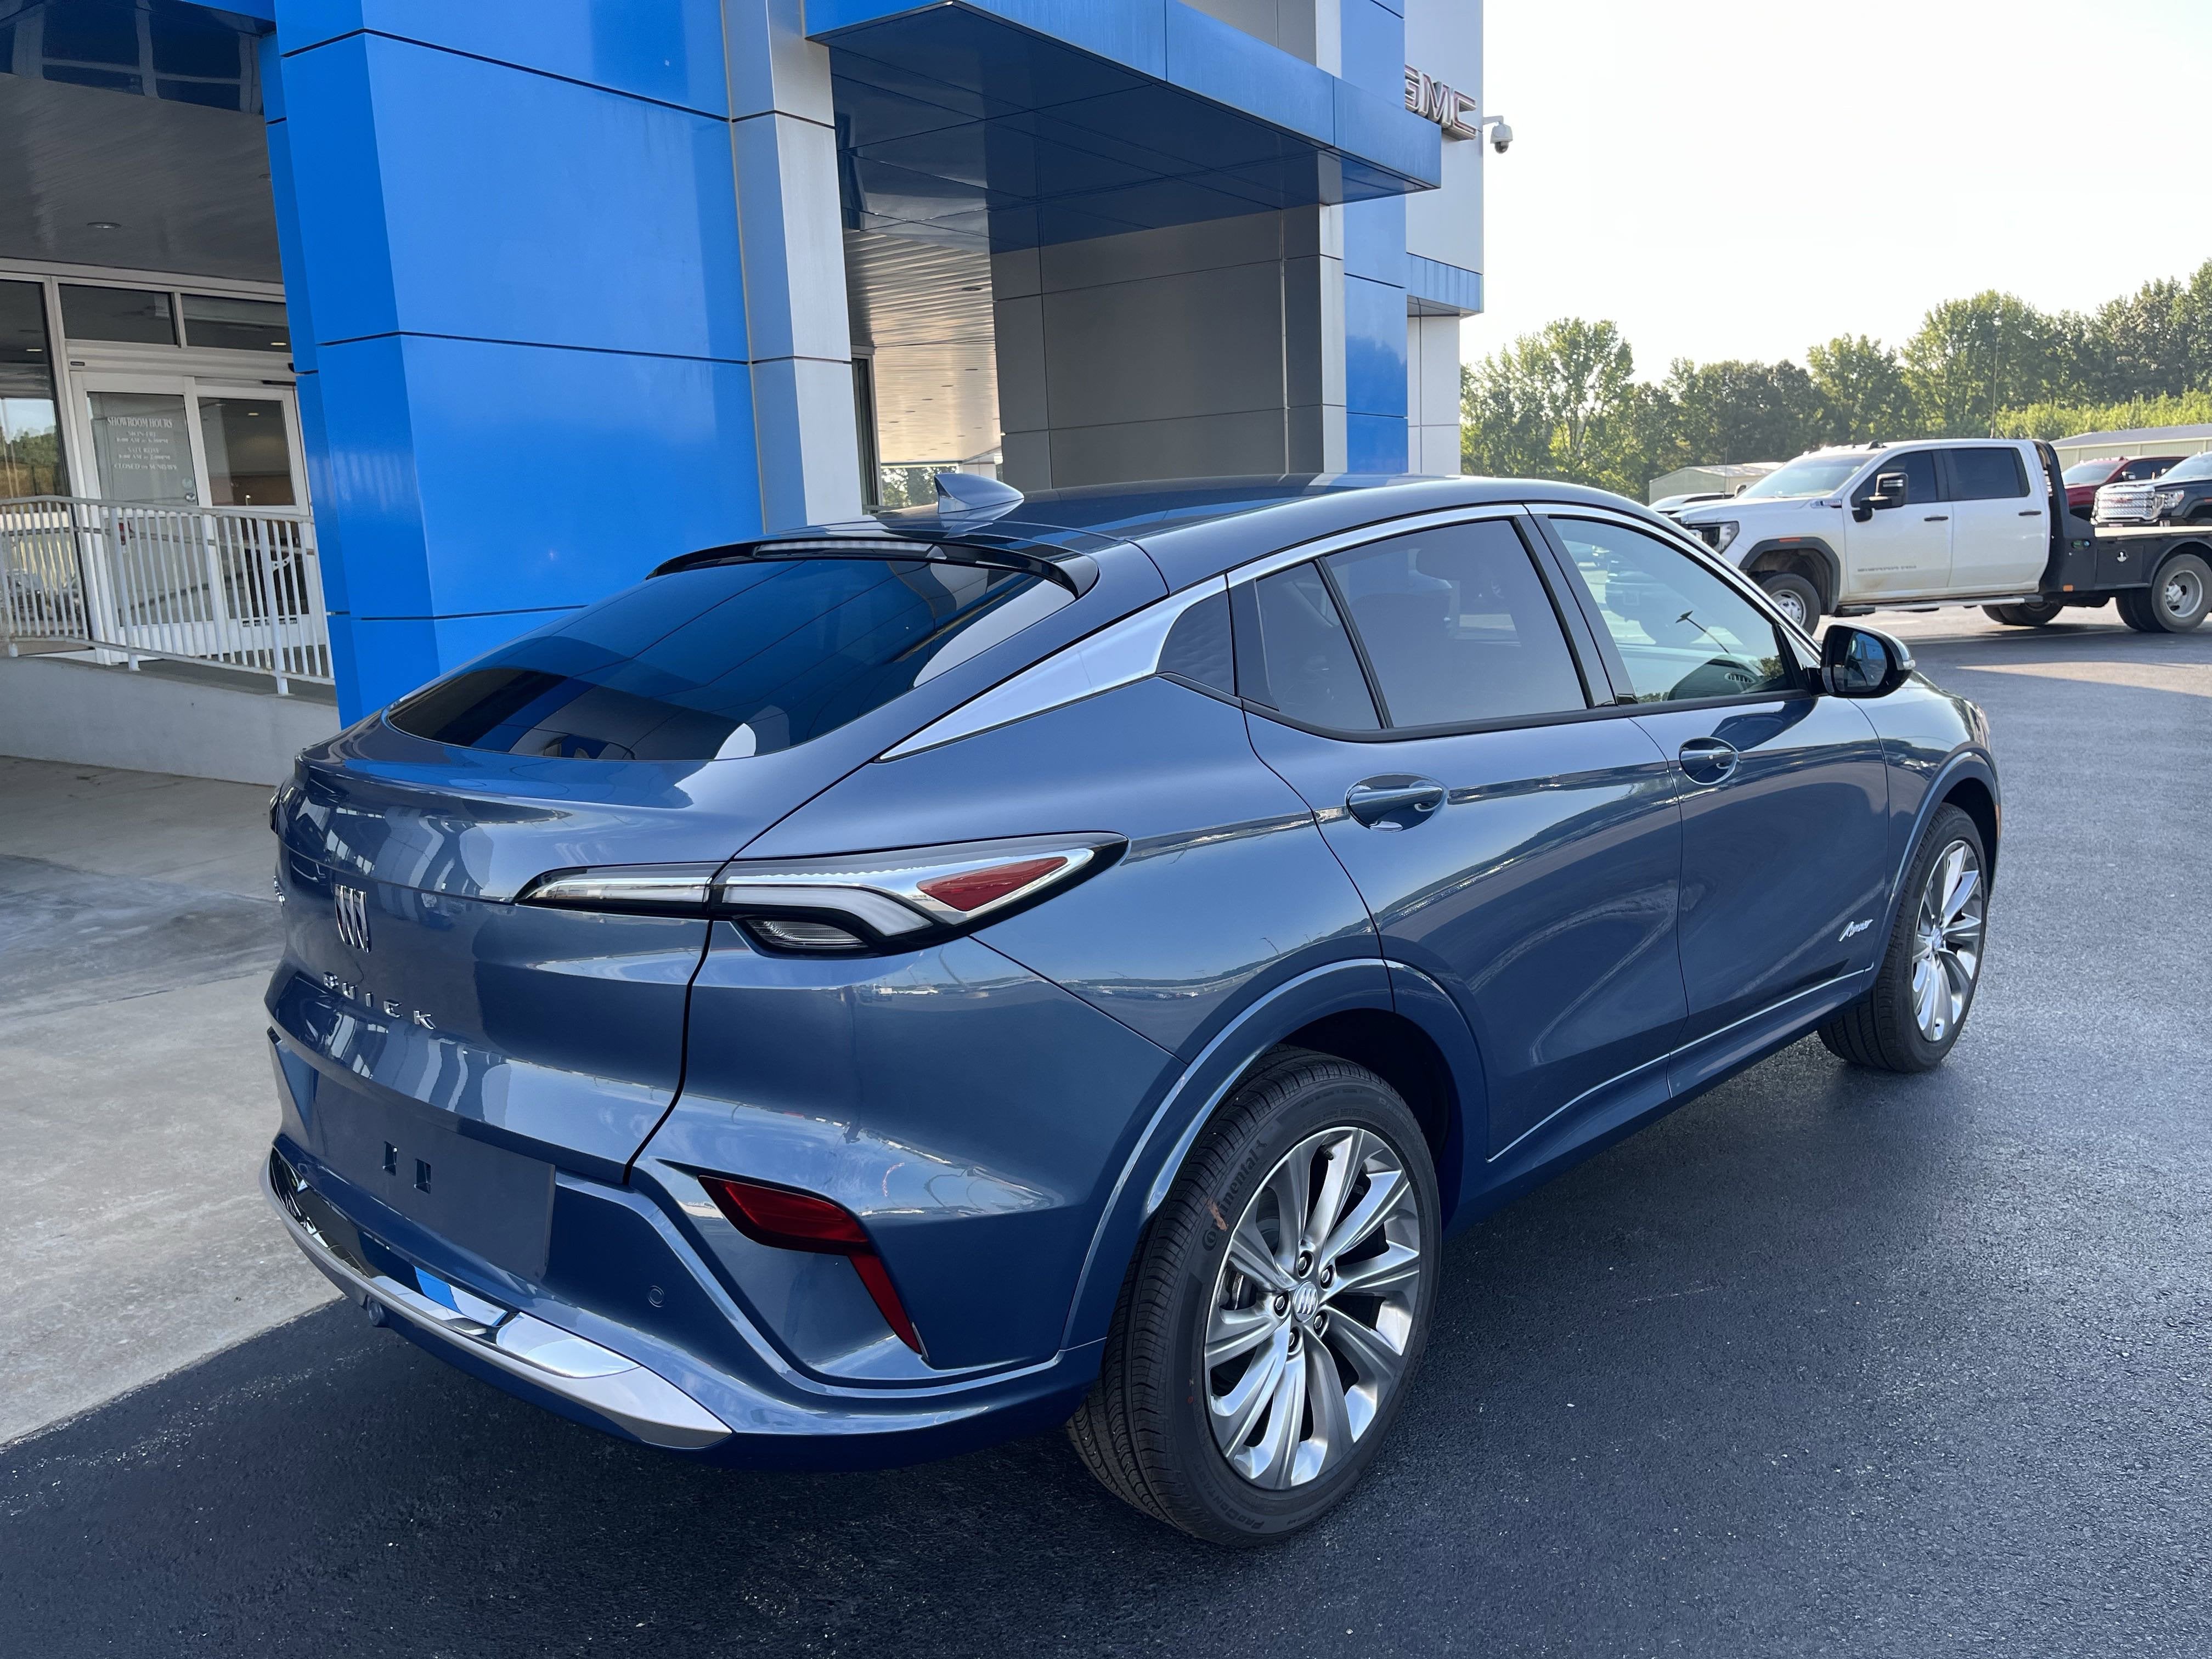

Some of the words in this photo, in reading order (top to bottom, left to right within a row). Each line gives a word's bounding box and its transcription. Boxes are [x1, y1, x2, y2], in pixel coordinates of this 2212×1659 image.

[107, 416, 148, 427] SHOWROOM
[149, 418, 173, 428] HOURS
[324, 972, 435, 1030] BUICK
[1203, 1149, 1260, 1251] Coinental
